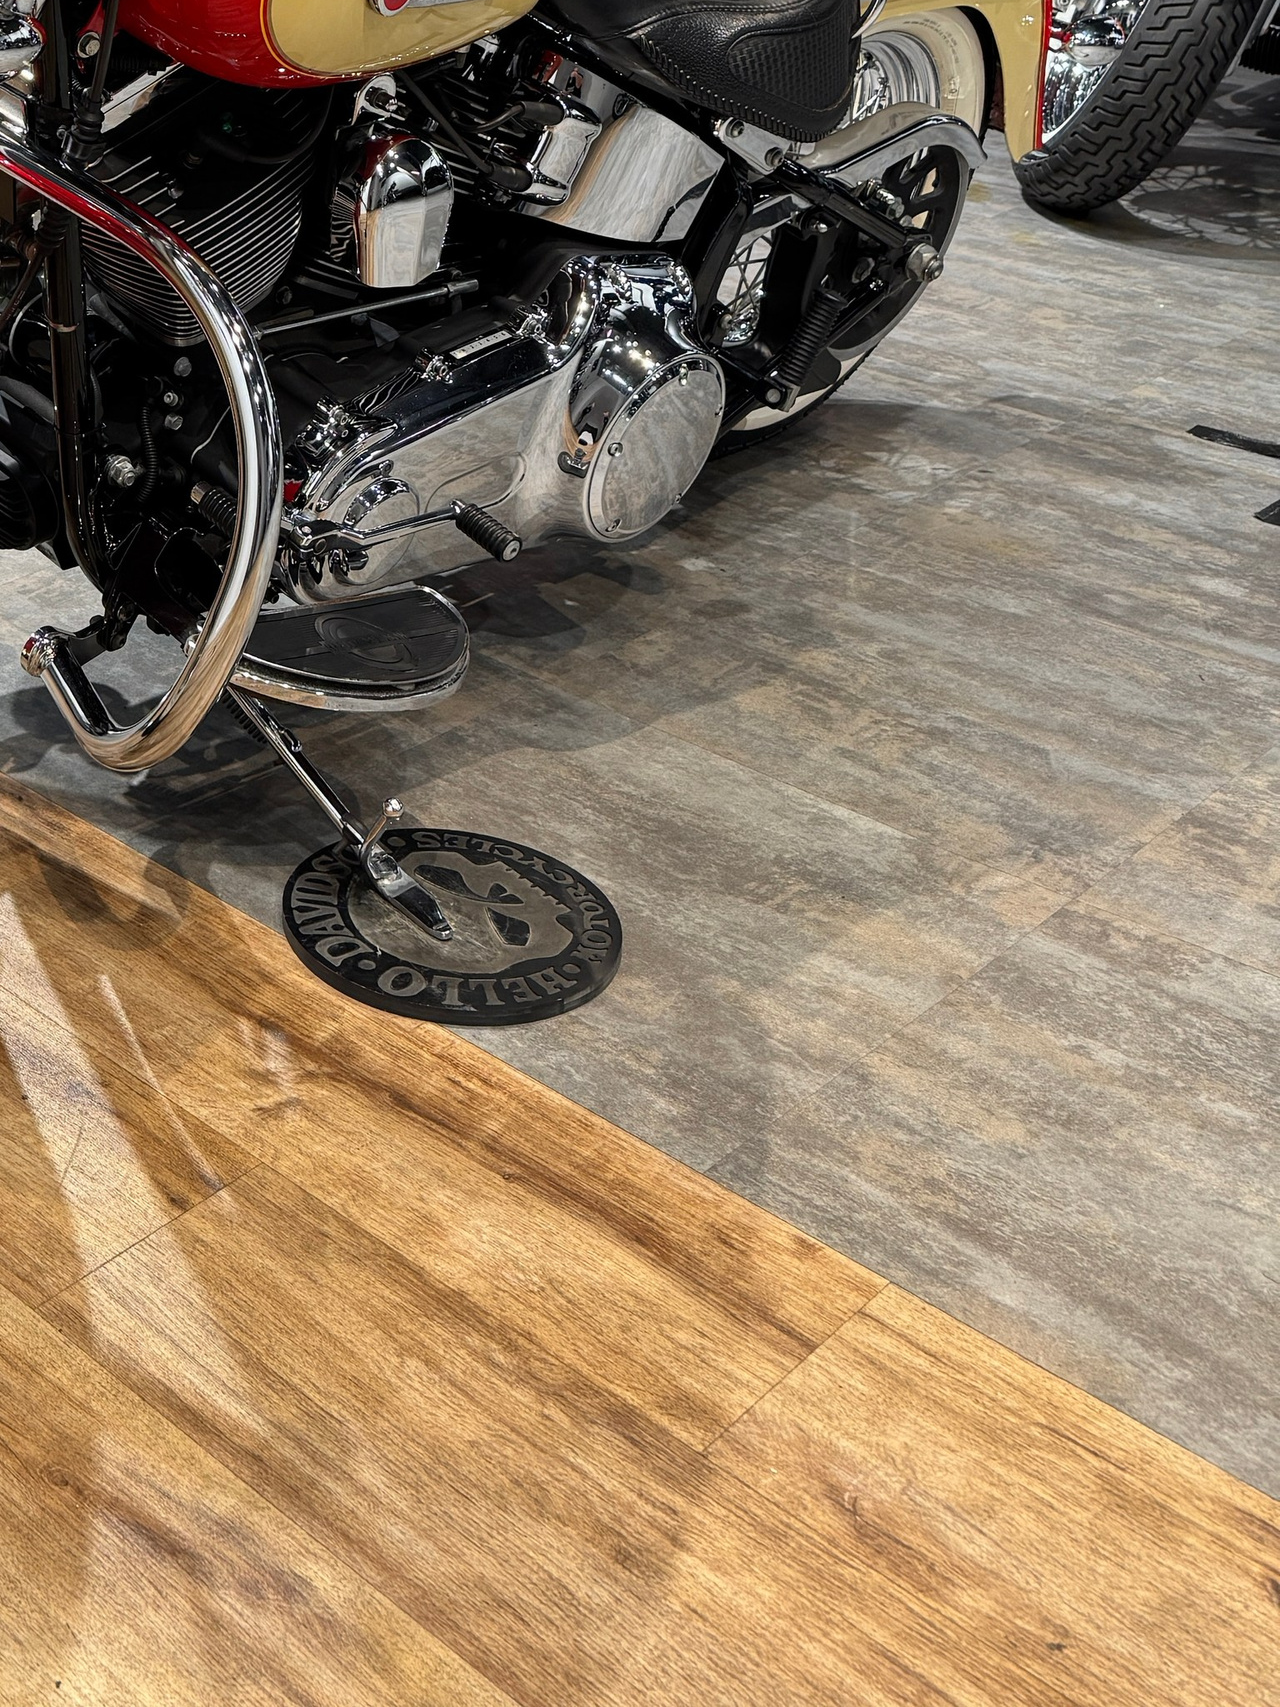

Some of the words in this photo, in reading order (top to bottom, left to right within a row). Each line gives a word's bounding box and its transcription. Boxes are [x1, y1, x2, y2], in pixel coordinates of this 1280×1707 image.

[290, 841, 375, 967] DAVIDSO
[411, 830, 613, 964] MOTORCYCLES
[377, 965, 578, 1007] HELLO
